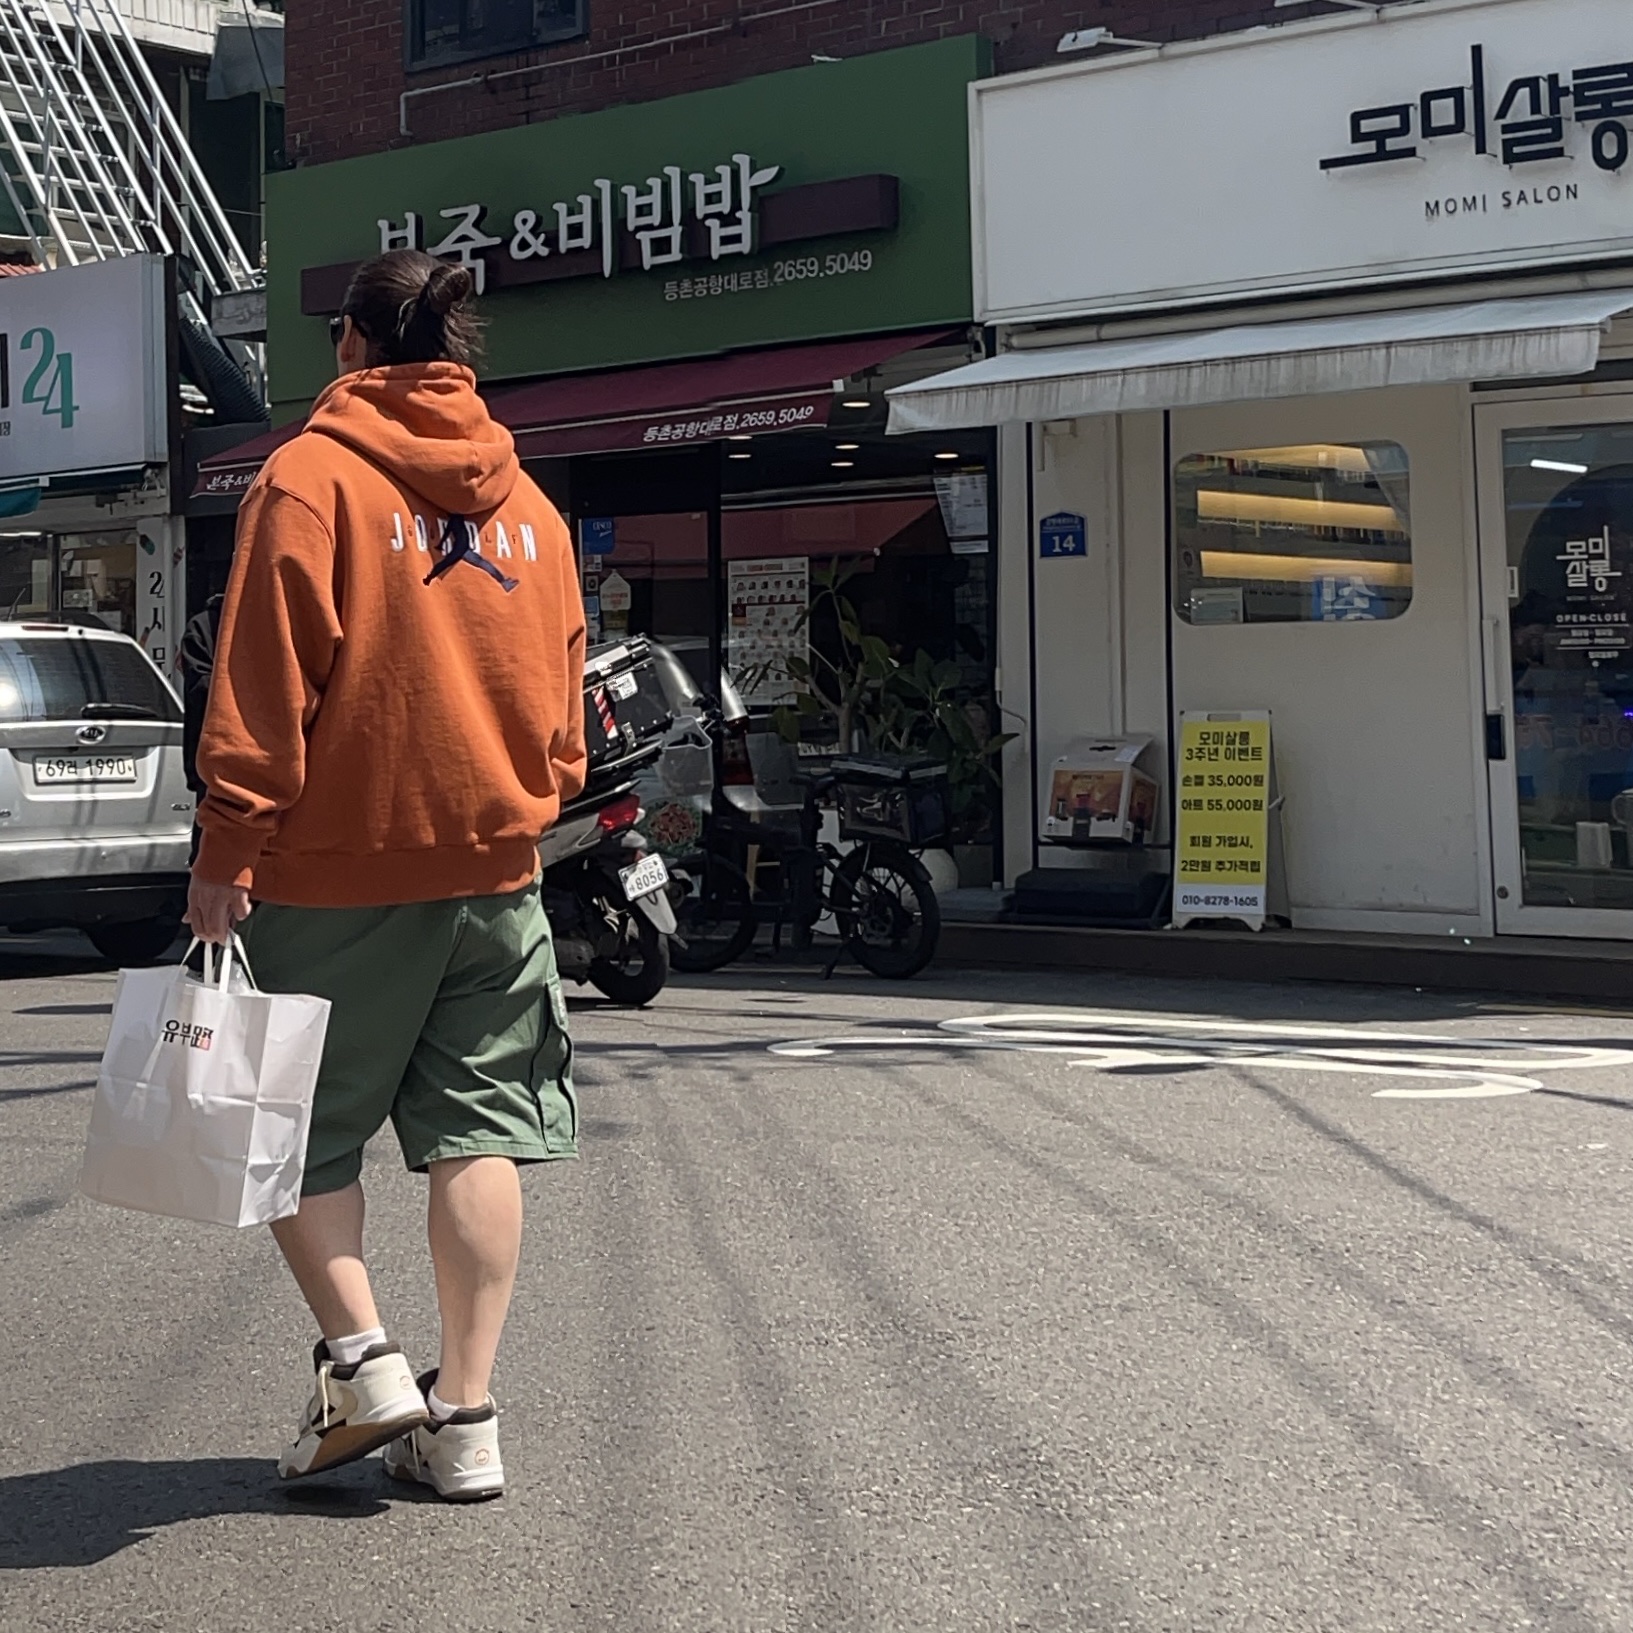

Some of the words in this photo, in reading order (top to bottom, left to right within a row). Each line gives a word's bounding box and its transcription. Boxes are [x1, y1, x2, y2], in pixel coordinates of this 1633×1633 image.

[1424, 194, 1487, 217] MOMI
[1502, 183, 1578, 207] SALON
[20, 327, 79, 429] 24
[1052, 535, 1076, 552] 14
[1556, 525, 1610, 560] 모미
[1566, 560, 1622, 592] 살롱
[87, 758, 126, 776] 1990
[1185, 747, 1219, 761] 3주년
[1224, 747, 1262, 761] 이벤트
[635, 868, 664, 890] 8056
